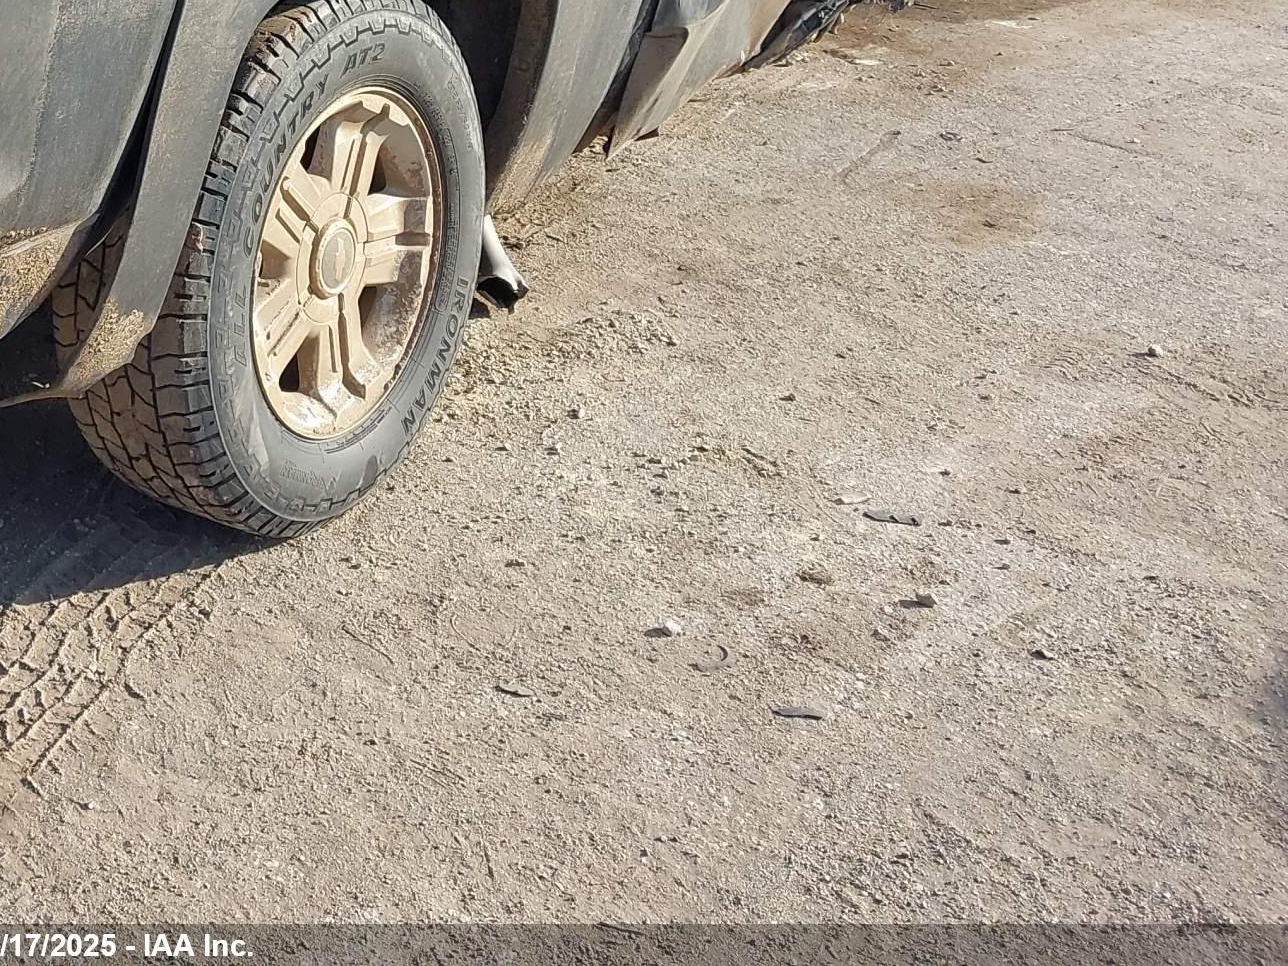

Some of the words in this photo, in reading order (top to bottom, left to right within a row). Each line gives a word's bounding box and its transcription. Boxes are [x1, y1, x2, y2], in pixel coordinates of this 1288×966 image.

[243, 72, 330, 259] COUNTRY
[341, 42, 386, 78] AT2
[400, 276, 469, 436] IRONMAN
